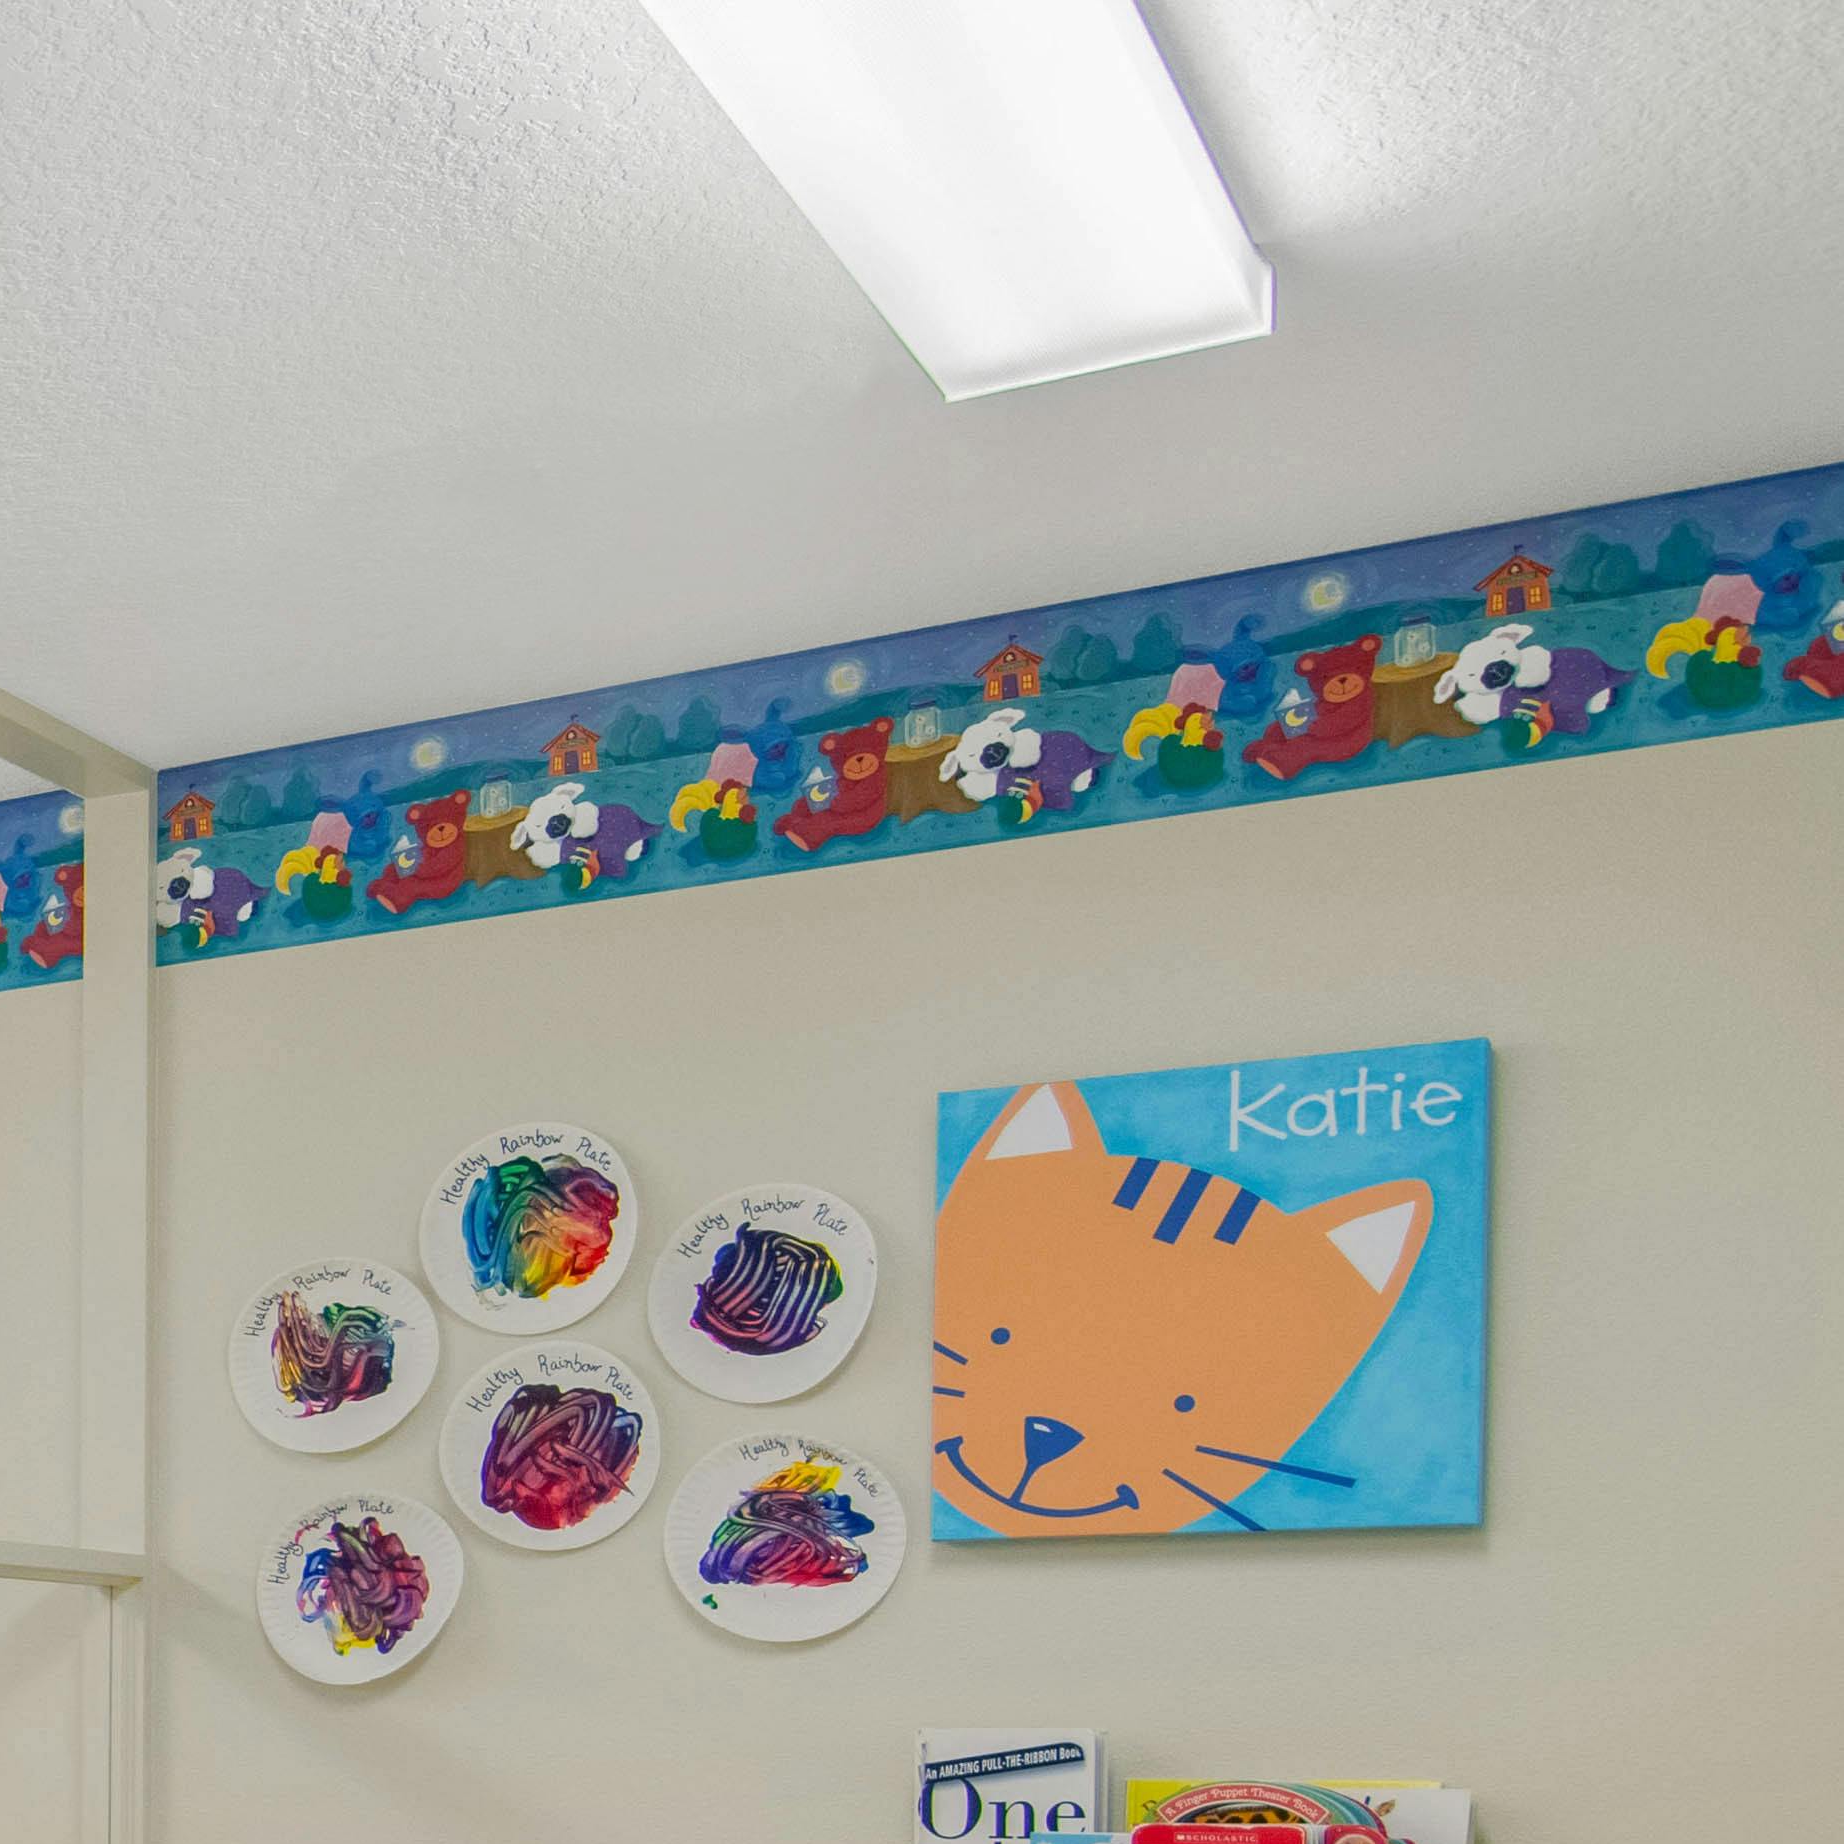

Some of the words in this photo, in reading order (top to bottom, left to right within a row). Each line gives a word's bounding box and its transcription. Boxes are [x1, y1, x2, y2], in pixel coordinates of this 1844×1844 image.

[1228, 1066, 1463, 1152] Katie
[440, 1153, 491, 1204] Healthy
[500, 1129, 564, 1154] Rainbow
[576, 1136, 612, 1171] Plate
[677, 1212, 730, 1258] Healthy
[741, 1194, 805, 1221] Rainbow
[812, 1203, 848, 1236] Plate
[292, 1265, 350, 1291] Rainbow
[362, 1269, 393, 1296] Plate
[466, 1367, 525, 1413] Healthy
[537, 1353, 604, 1376] Rainbow
[359, 1499, 395, 1515] Plate
[925, 1766, 938, 1781] An
[939, 1759, 980, 1779] AMAZING
[981, 1747, 1057, 1773] PULL-THE-RIBBON
[917, 1777, 1086, 1840] One
[1165, 1805, 1177, 1818] A
[1174, 1791, 1209, 1810] Finger
[1210, 1787, 1248, 1799] Puppet
[1251, 1787, 1292, 1804] Theater
[1292, 1797, 1320, 1819] Book
[1185, 1832, 1257, 1843] SCHOLASTIC
